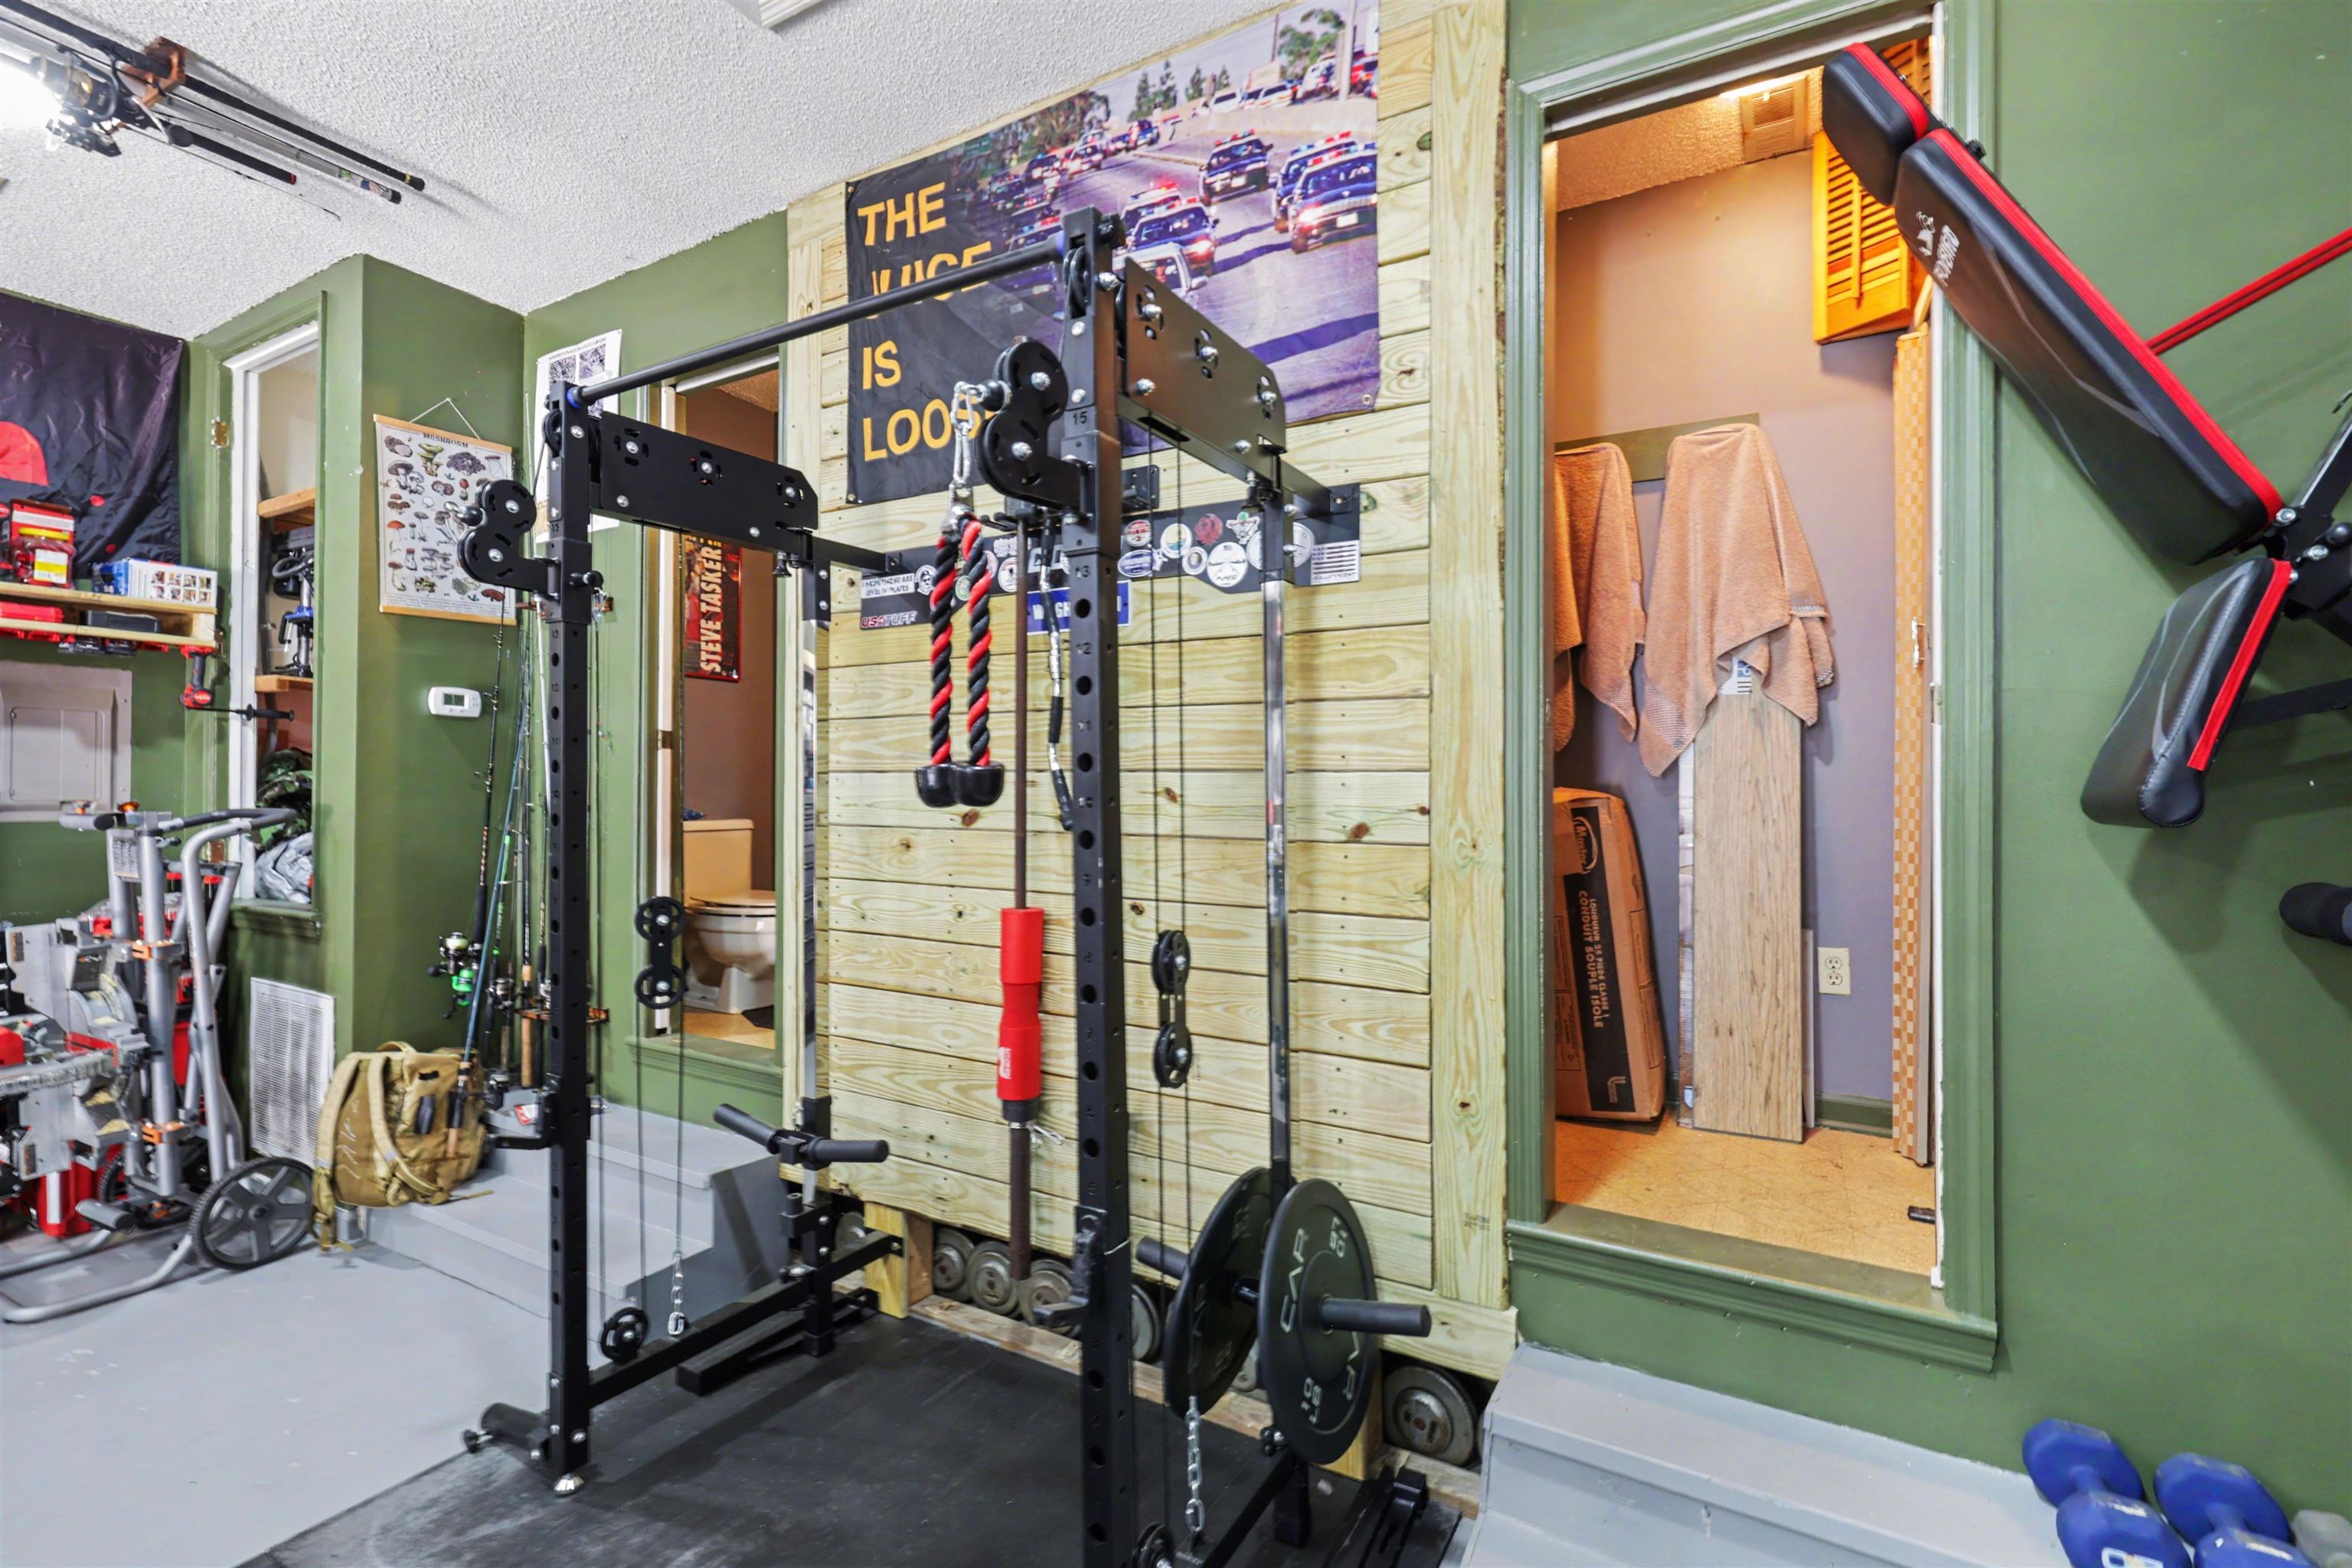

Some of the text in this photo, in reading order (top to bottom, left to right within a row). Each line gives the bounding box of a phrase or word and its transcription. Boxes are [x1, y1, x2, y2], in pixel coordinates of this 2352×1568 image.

[858, 181, 946, 247] THE
[862, 340, 902, 390] IS
[863, 392, 994, 462] LOOS
[1073, 411, 1087, 425] 15
[699, 545, 722, 673] STEVE TASKER
[1579, 890, 1593, 943] CONDUIT
[1584, 946, 1599, 991] SOUPLE
